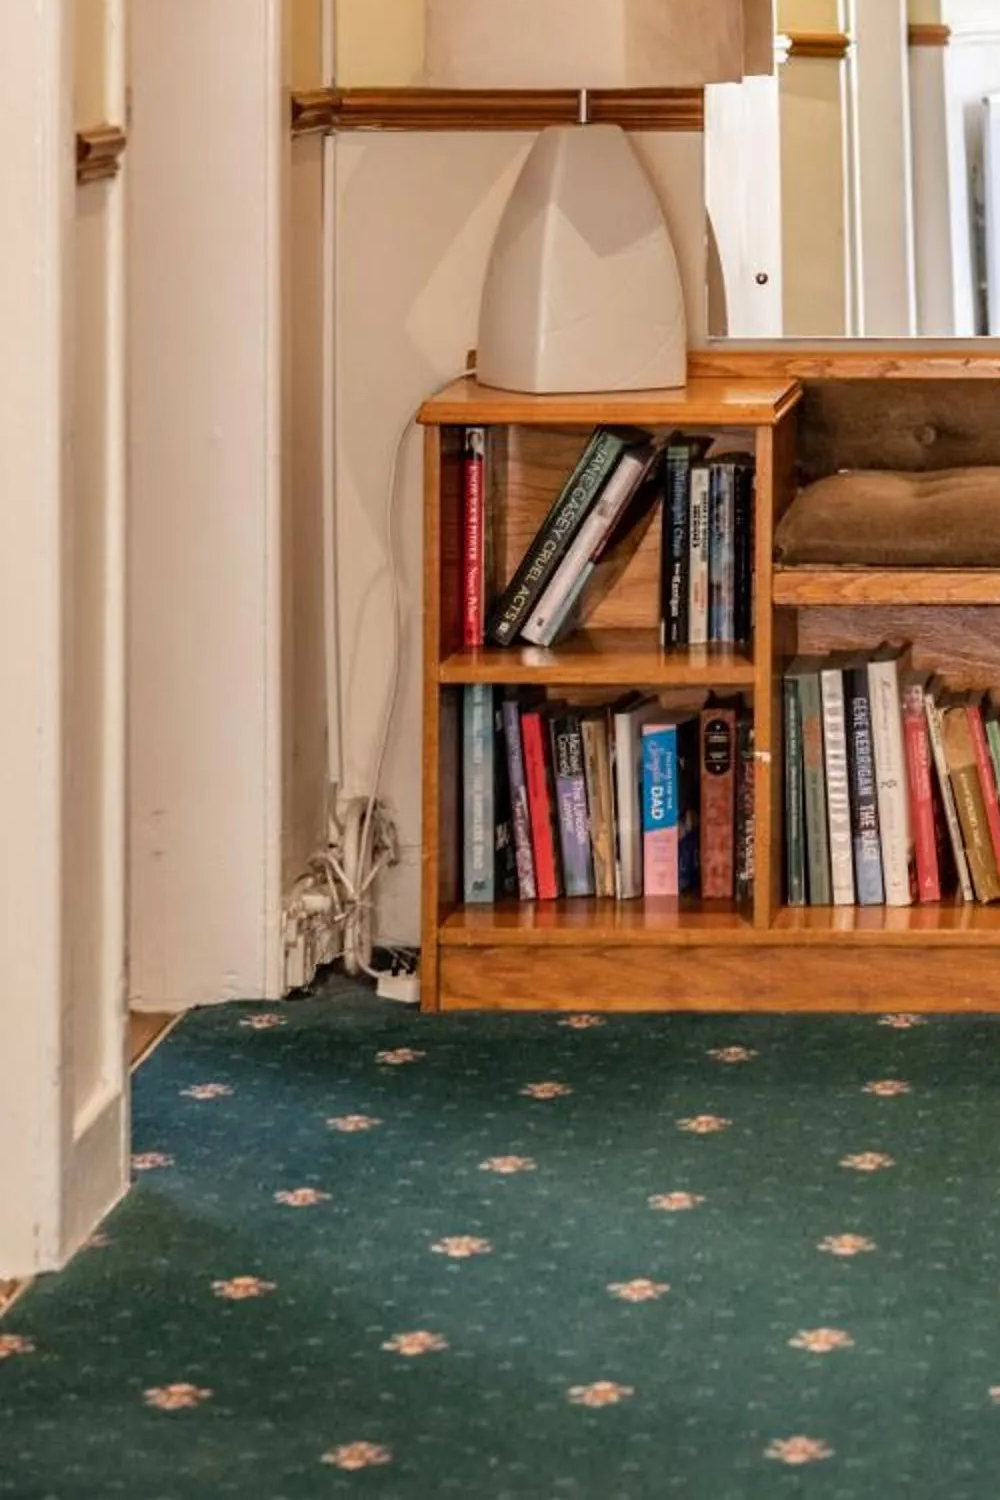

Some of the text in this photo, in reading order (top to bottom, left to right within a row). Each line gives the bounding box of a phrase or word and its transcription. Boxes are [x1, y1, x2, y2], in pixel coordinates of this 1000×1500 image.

[551, 443, 608, 541] JANE CASEY
[503, 539, 557, 623] CRUEL ACTS
[852, 697, 873, 796] GENE KERRIGAN
[650, 785, 665, 820] DAD
[860, 804, 876, 827] THE
